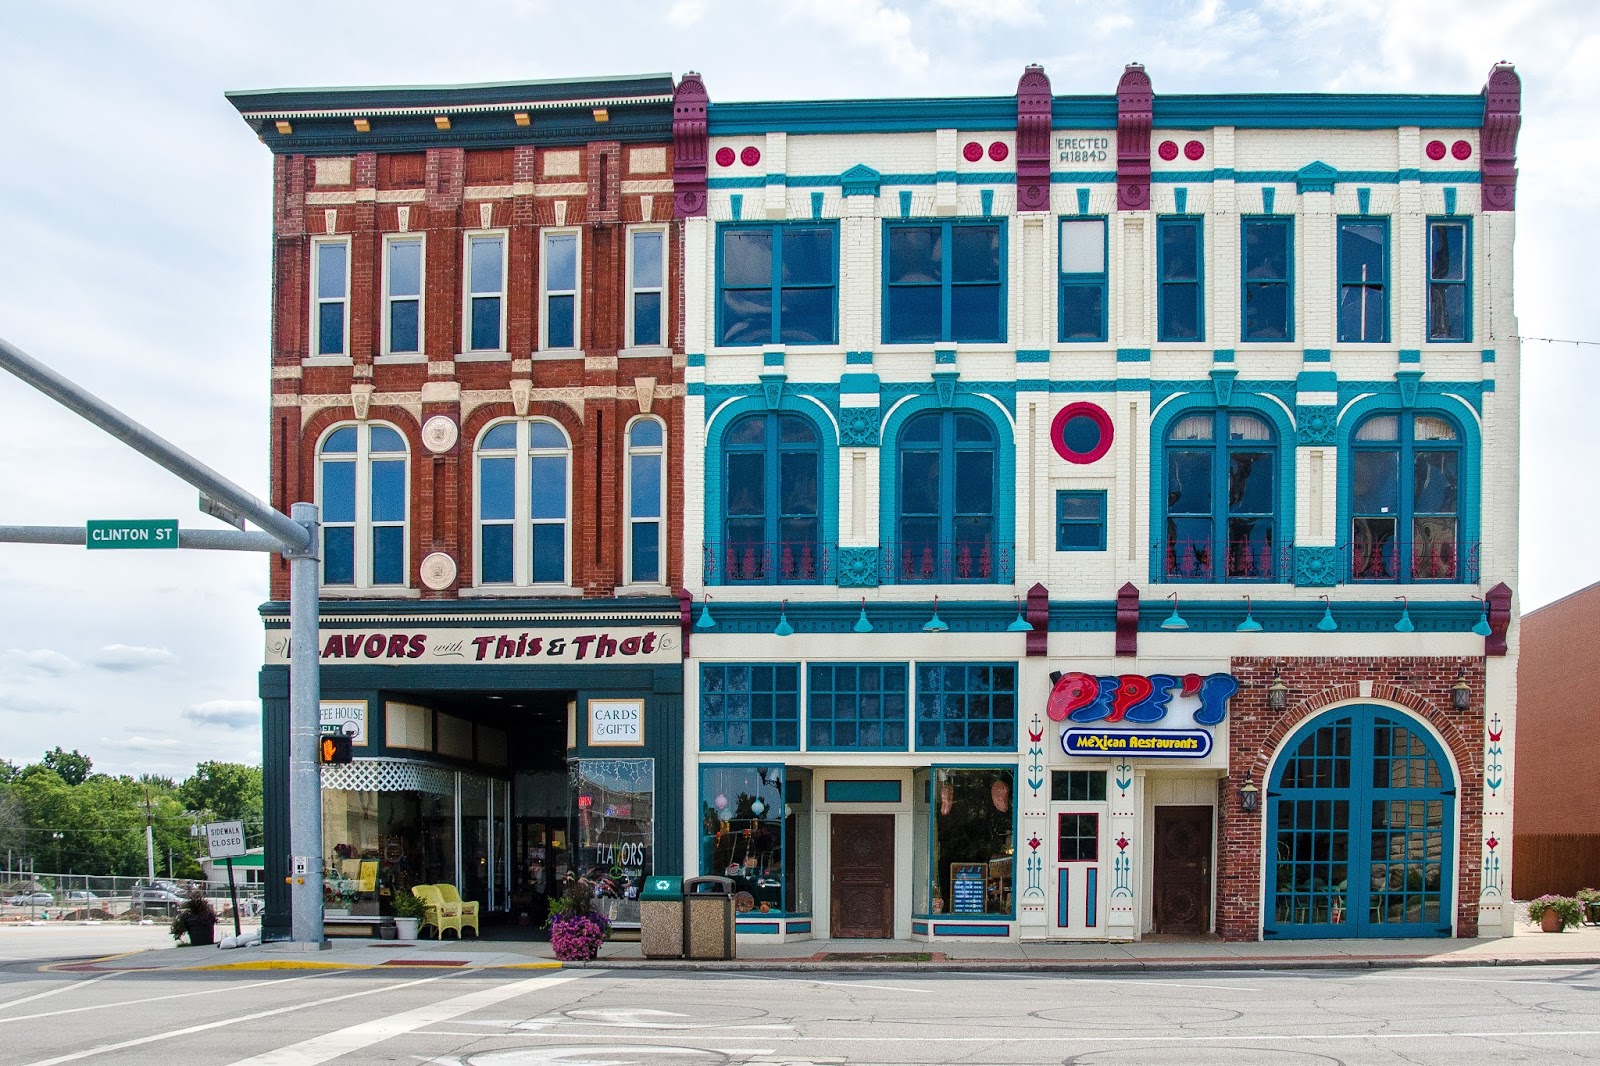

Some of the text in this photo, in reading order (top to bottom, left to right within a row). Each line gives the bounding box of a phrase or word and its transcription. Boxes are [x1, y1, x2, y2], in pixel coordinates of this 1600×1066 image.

[1057, 138, 1108, 149] ERECTED
[92, 528, 173, 541] CLINTON ST
[287, 631, 657, 661] AVORS with This & That
[335, 707, 363, 720] HOUSE
[595, 709, 638, 720] CARDS
[1076, 735, 1198, 750] Mexican Restaurants
[578, 796, 592, 807] OPEN
[210, 827, 240, 836] SIDEWALK
[211, 837, 241, 847] CLOSED
